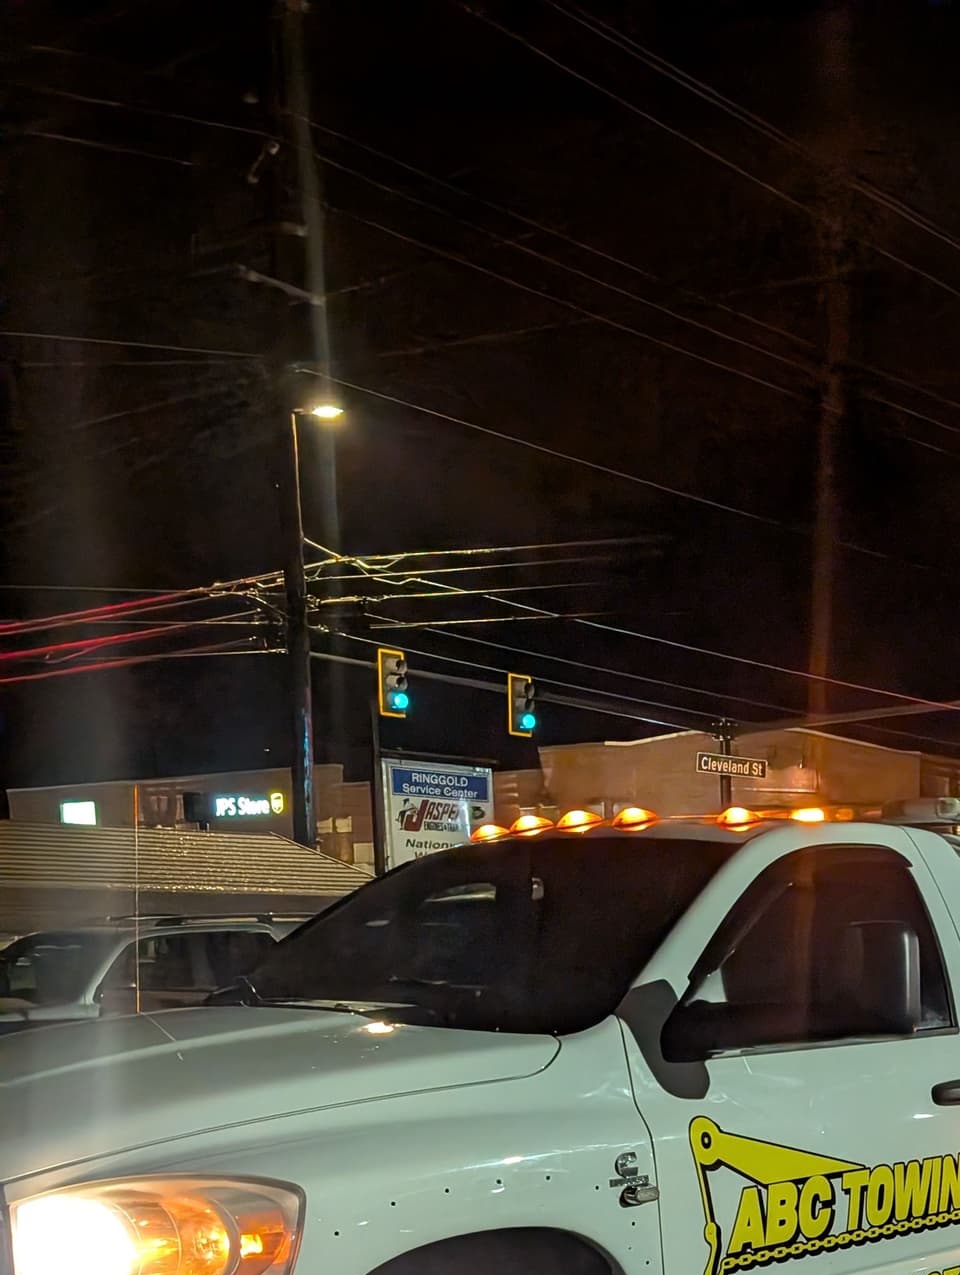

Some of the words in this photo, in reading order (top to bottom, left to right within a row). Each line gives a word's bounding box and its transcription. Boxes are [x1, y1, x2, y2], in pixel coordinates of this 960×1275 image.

[701, 756, 750, 774] Cleveland
[752, 762, 762, 776] St
[411, 772, 469, 788] RINGGOLD
[402, 783, 441, 796] Service
[443, 786, 478, 799] Center
[404, 799, 462, 832] JASPE
[727, 1174, 835, 1256] ABC
